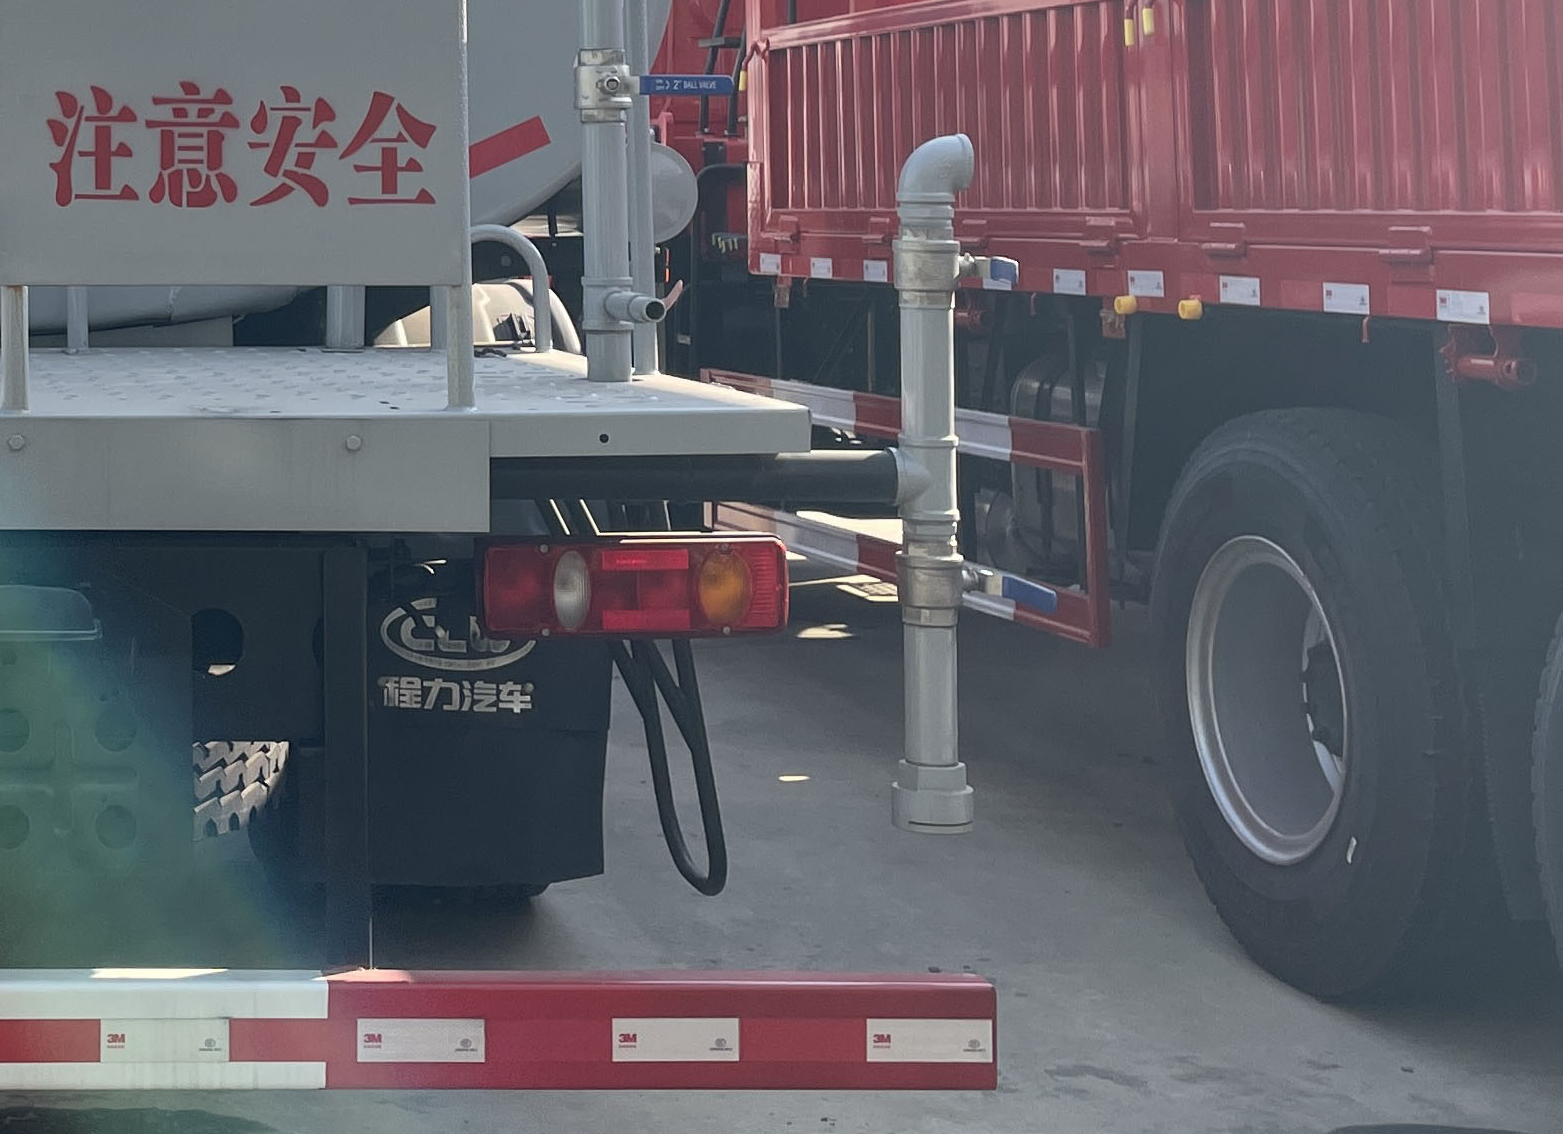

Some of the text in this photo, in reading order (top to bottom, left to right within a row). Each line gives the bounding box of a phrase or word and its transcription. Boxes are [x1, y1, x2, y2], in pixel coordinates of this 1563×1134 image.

[46, 80, 437, 209] 注意安全
[382, 676, 532, 714] 程力汽车
[107, 1033, 126, 1043] 3M
[364, 1033, 382, 1043] 3M
[619, 1033, 637, 1043] 3M
[873, 1033, 891, 1044] 3M
